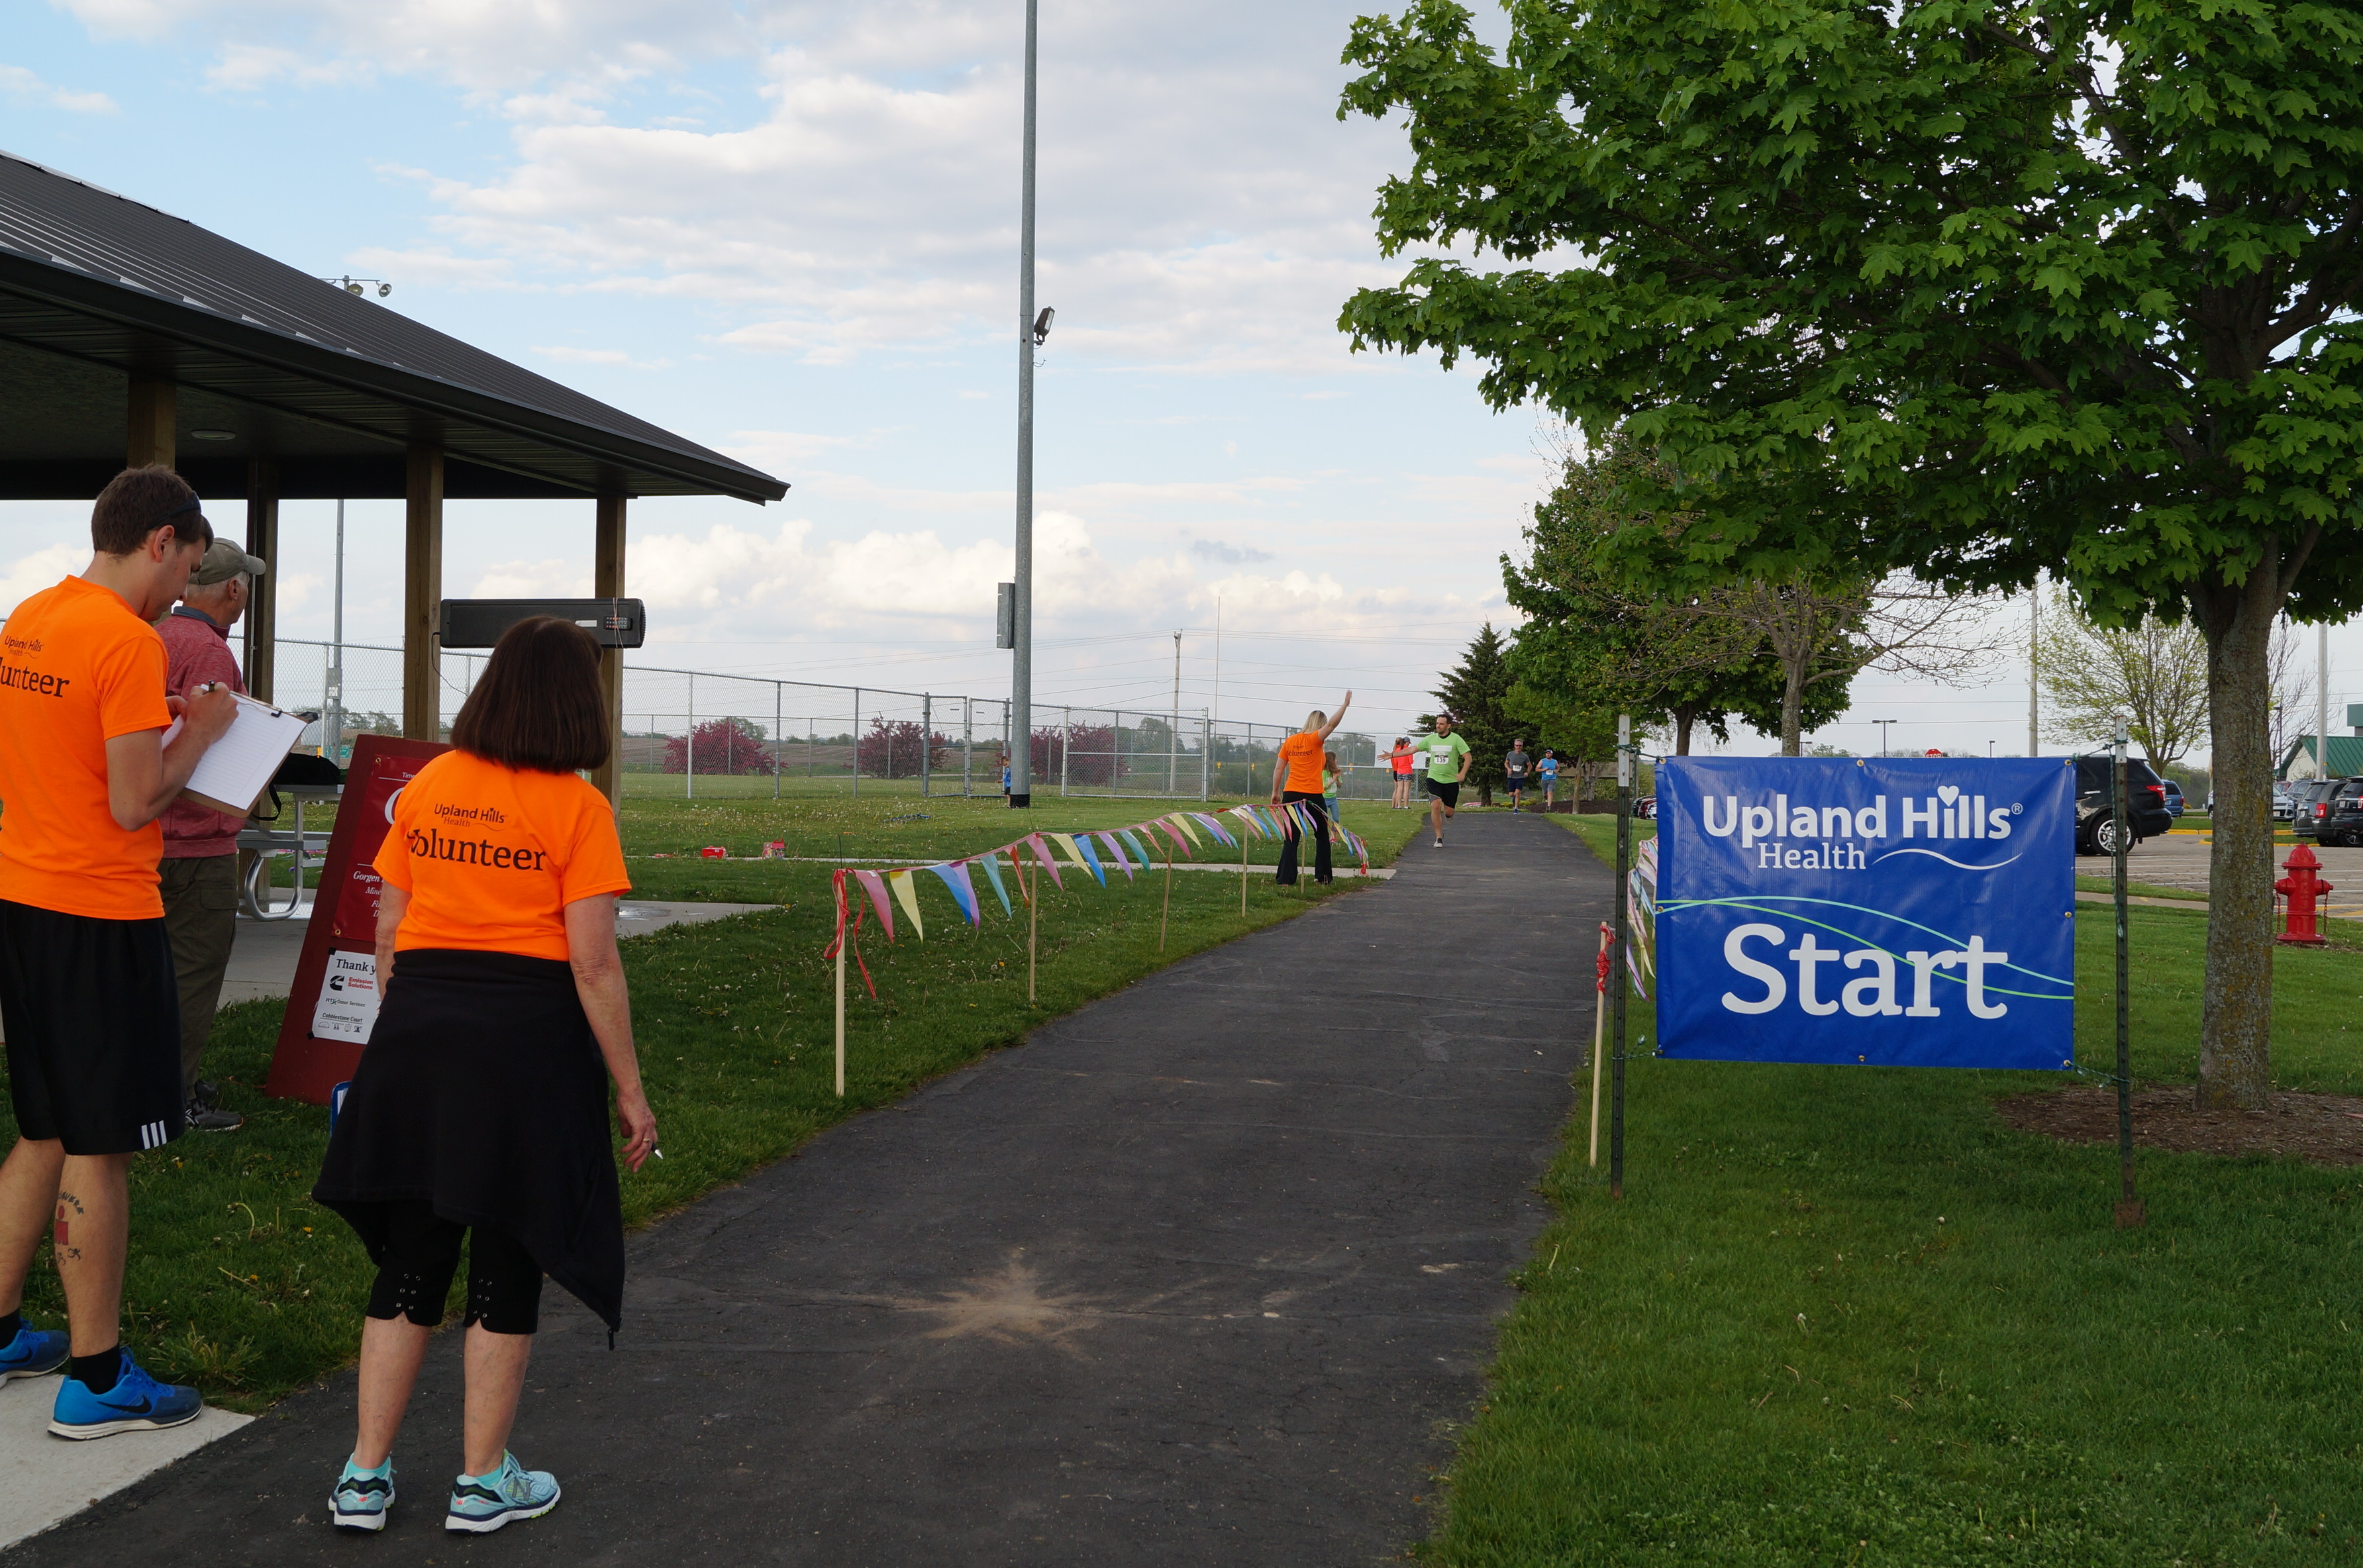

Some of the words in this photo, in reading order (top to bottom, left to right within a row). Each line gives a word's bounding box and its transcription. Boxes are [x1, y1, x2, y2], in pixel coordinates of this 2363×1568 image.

[434, 803, 478, 819] Upland
[443, 816, 471, 828] Health
[1703, 794, 1887, 848] Upland
[1758, 842, 1867, 870] Health
[353, 870, 380, 883] Gorgen
[365, 886, 382, 896] Mine
[336, 958, 369, 972] Thank
[1722, 923, 2009, 1020] Start
